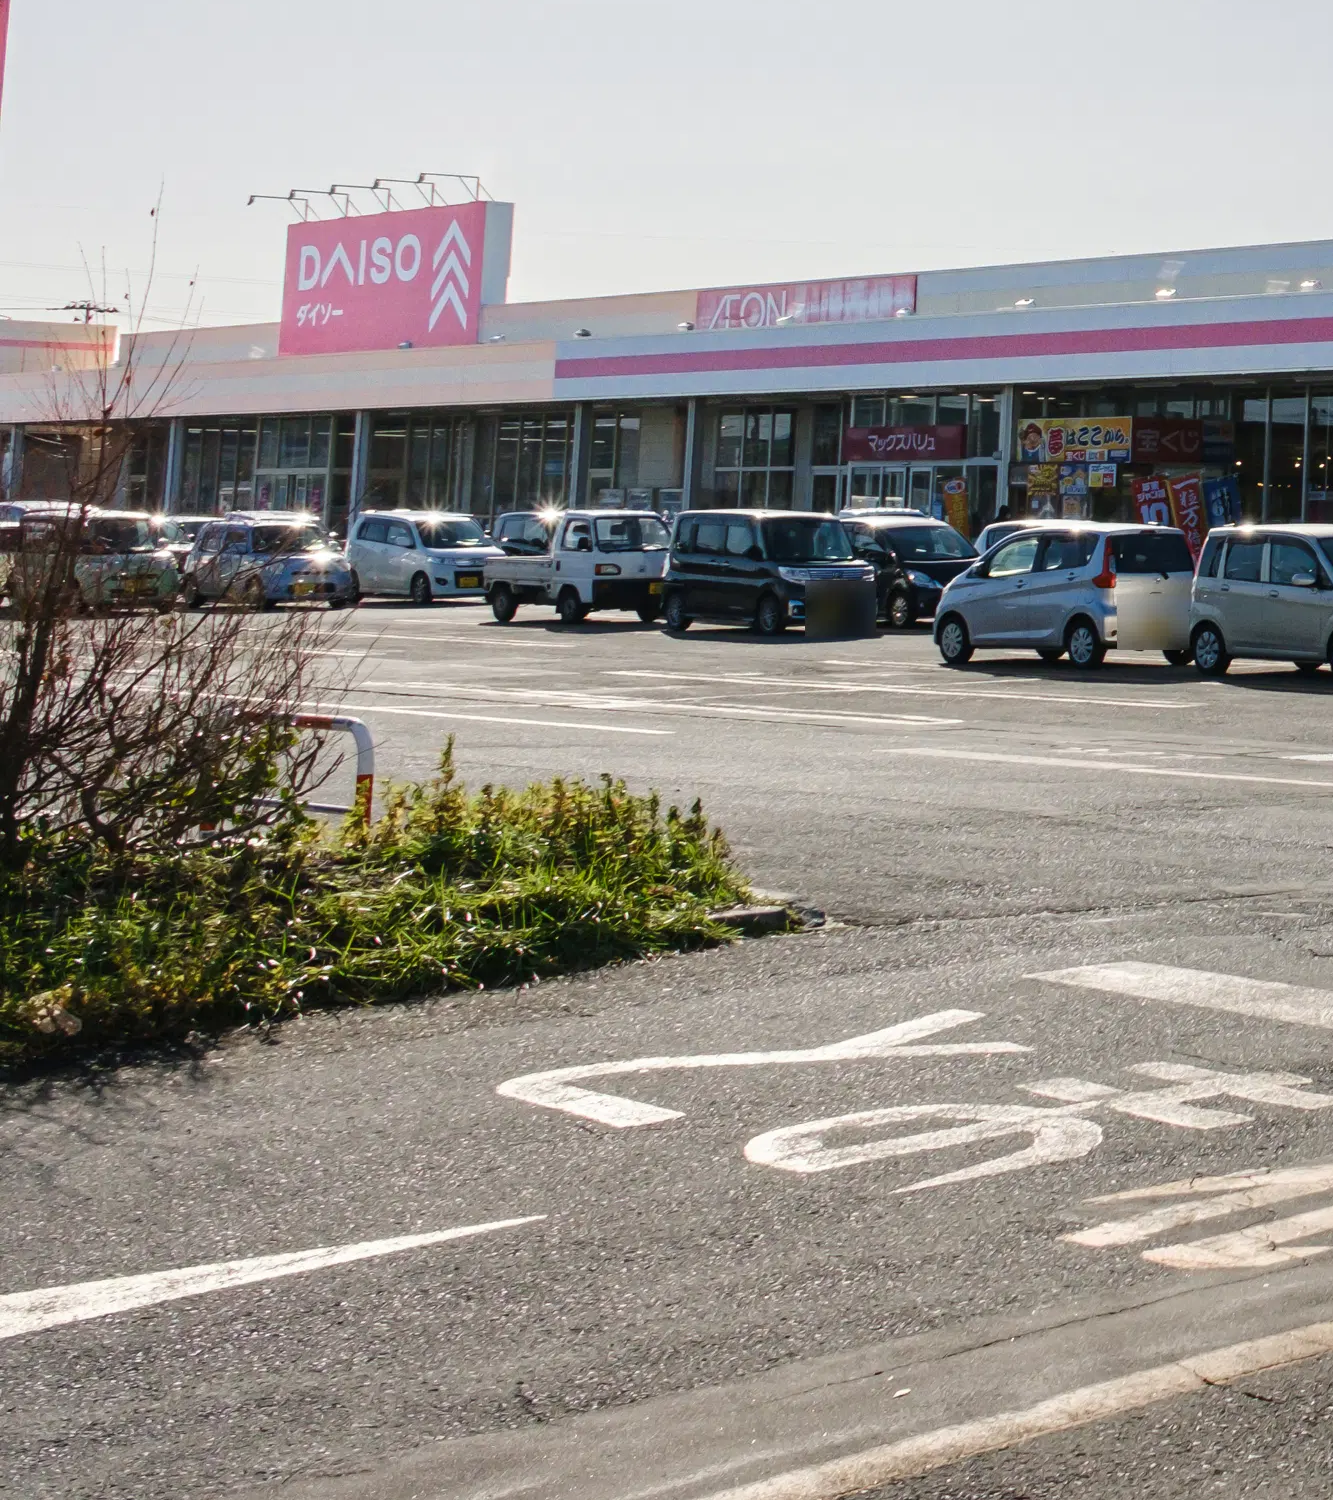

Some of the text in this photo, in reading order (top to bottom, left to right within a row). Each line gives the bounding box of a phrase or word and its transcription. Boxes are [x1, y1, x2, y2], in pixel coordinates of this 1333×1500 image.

[297, 233, 422, 291] DAISO
[296, 302, 344, 327] ダイソー
[867, 433, 936, 451] マックスバリュ
[1136, 429, 1200, 453] 宝くじ
